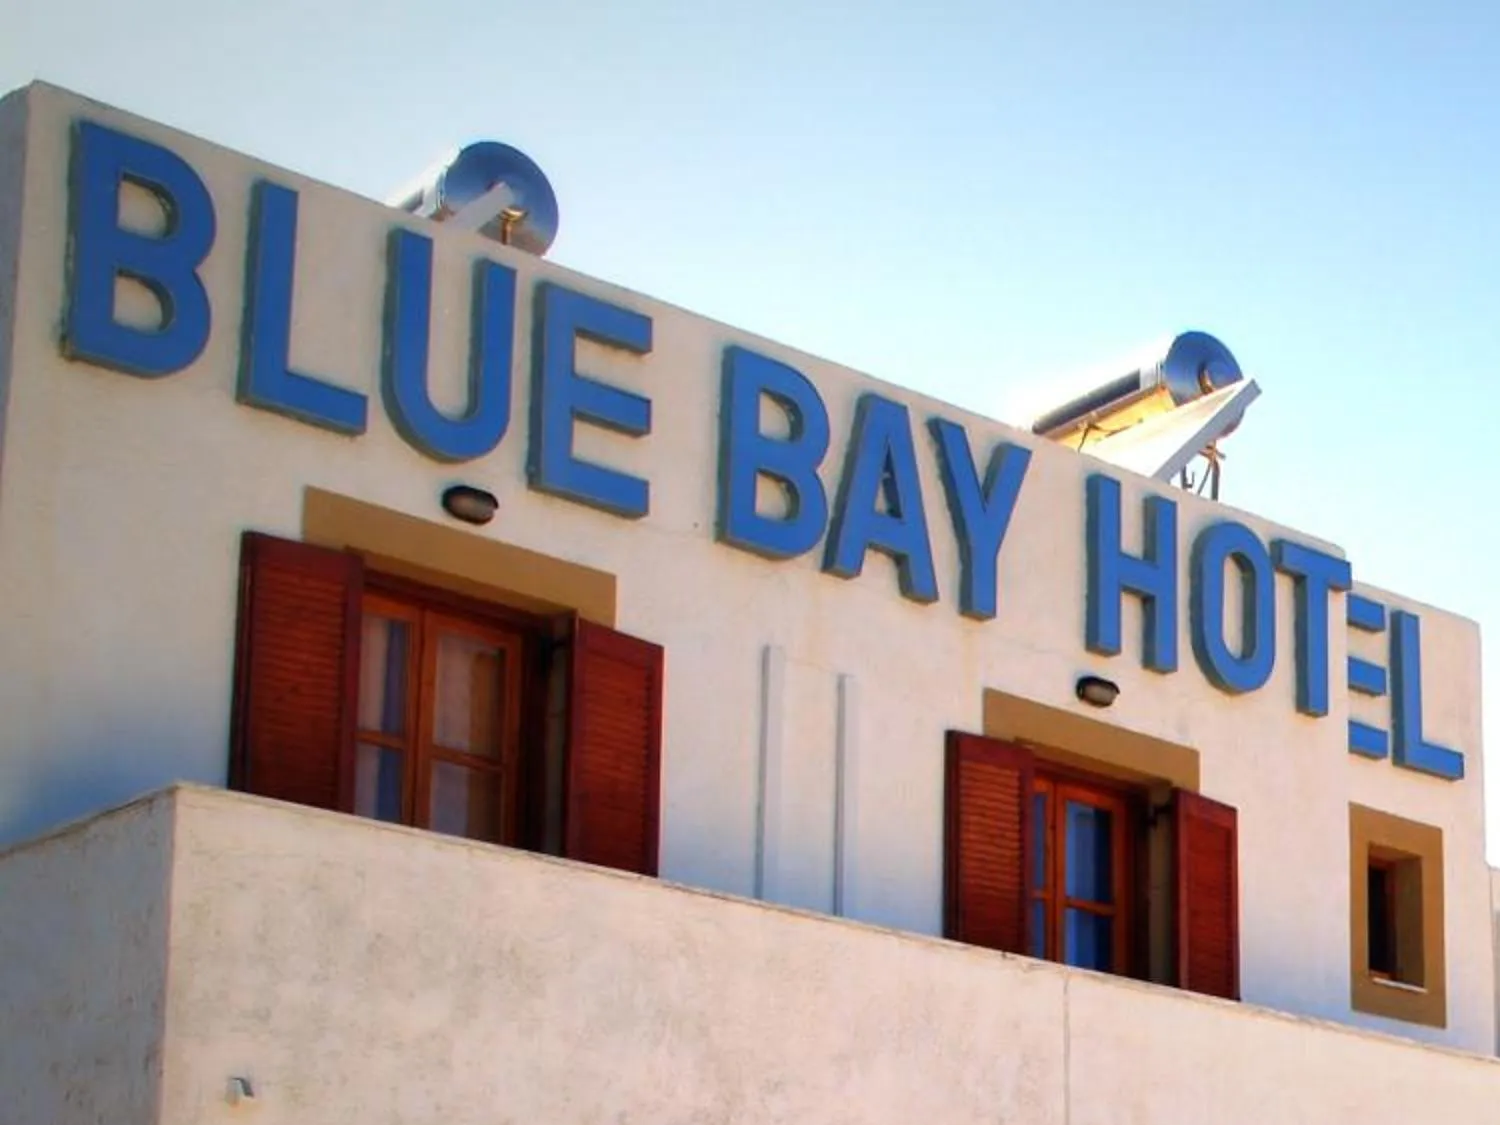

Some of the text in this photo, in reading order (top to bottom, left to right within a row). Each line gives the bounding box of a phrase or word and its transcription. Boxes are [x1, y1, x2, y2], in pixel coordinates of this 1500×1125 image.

[62, 118, 1465, 781] BLUE BAY HOTEL
